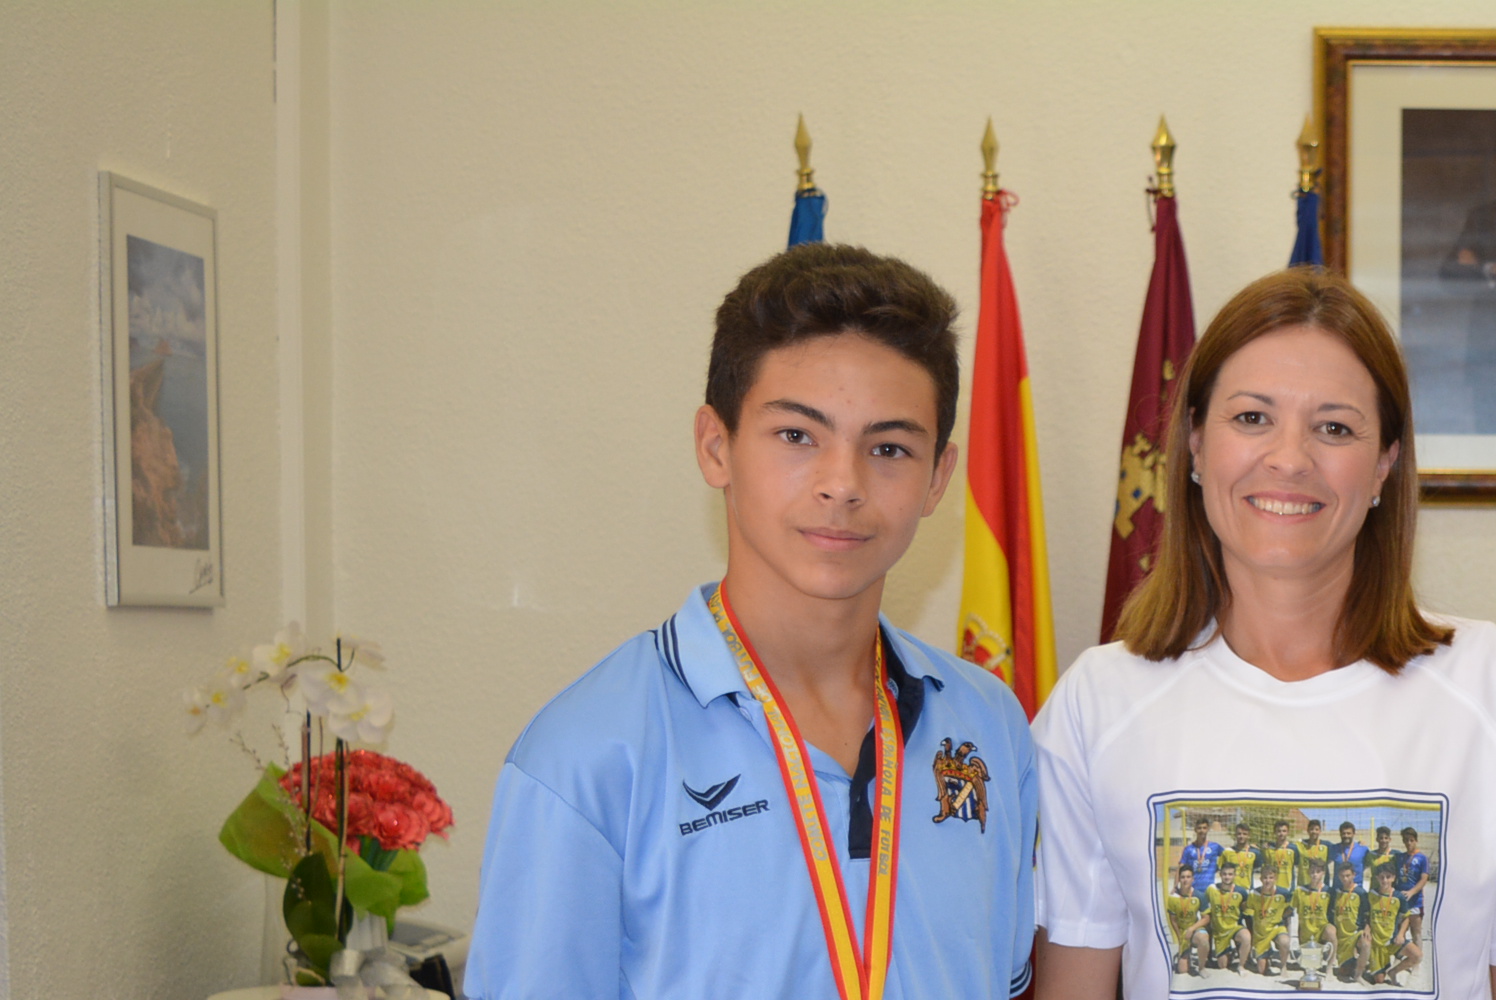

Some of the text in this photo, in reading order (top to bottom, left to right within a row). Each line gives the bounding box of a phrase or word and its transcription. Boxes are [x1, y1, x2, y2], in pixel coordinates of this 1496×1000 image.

[752, 683, 773, 703] DE
[767, 706, 808, 789] NACIONAL
[679, 799, 770, 836] BEMISER
[880, 805, 892, 823] DE
[877, 829, 891, 876] FUTBOL
